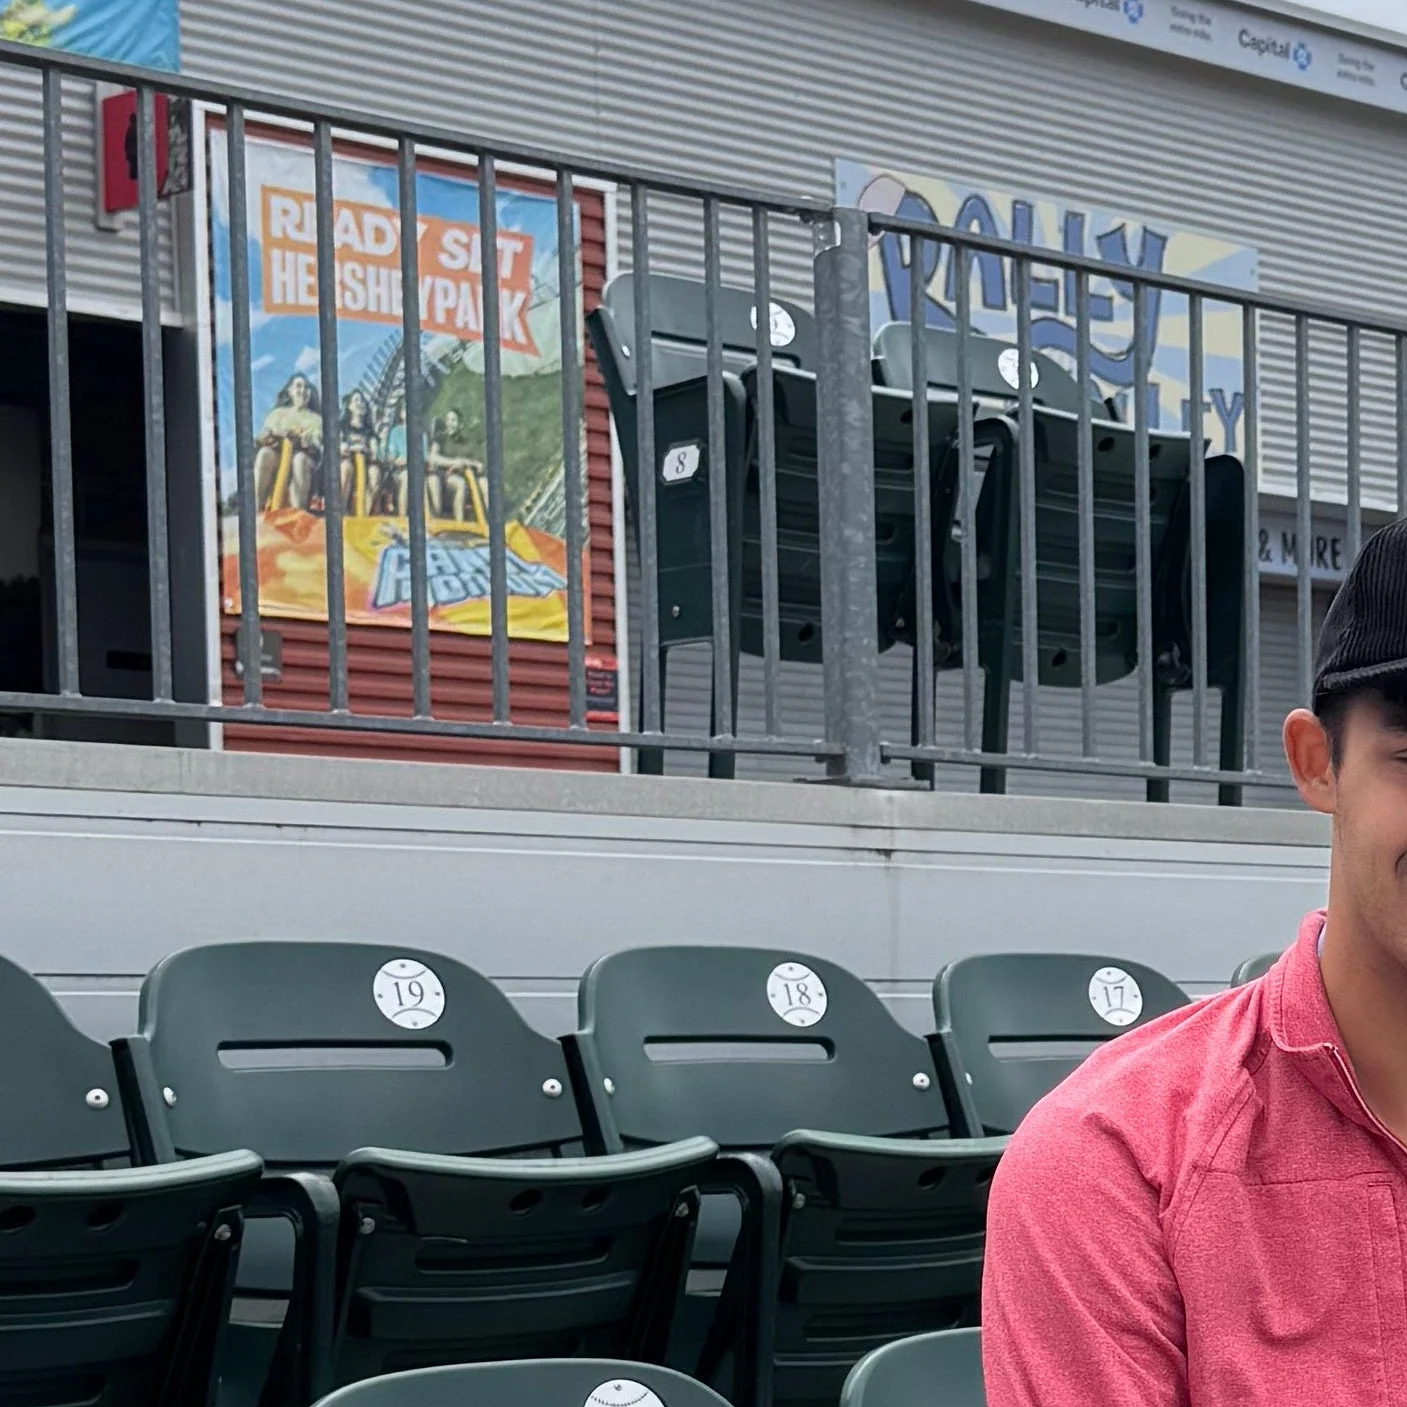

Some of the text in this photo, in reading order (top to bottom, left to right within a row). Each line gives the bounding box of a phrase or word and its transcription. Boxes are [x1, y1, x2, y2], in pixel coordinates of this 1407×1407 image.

[1238, 28, 1291, 60] Capital
[877, 188, 1168, 386] RALLY
[675, 452, 687, 474] 8
[1281, 531, 1342, 570] MRE
[394, 981, 424, 1006] 19
[784, 982, 811, 1006] 18
[1104, 986, 1124, 1008] 17
